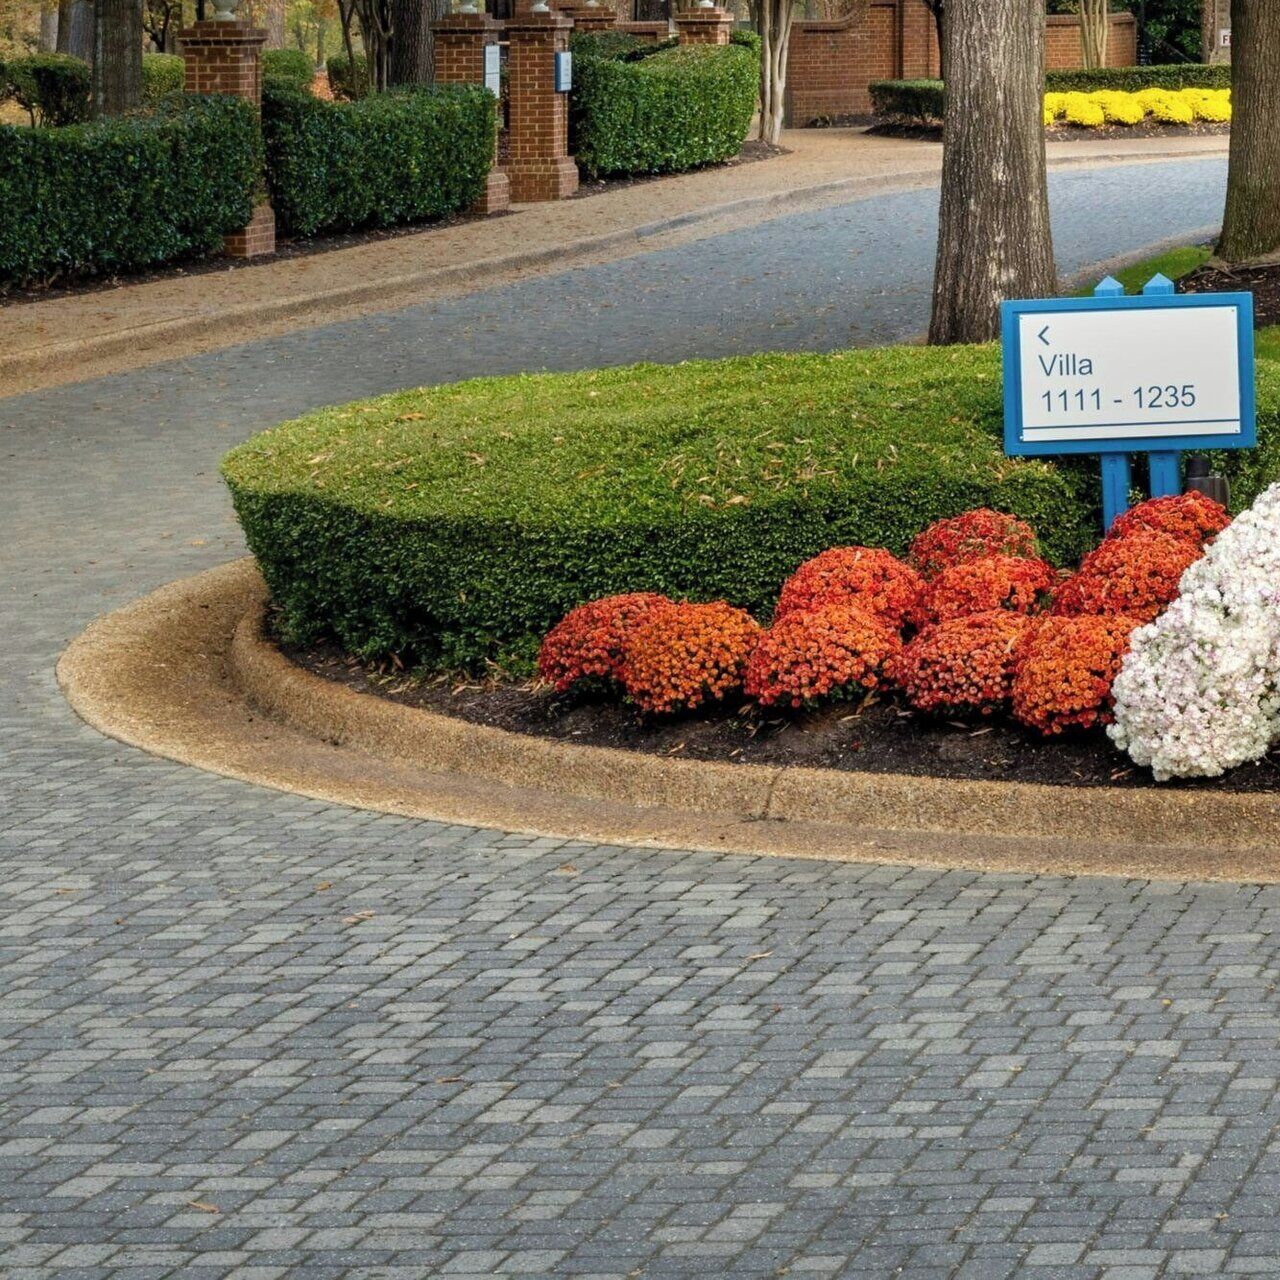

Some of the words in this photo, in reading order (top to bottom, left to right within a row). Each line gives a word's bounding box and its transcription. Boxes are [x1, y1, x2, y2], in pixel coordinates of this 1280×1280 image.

[1038, 353, 1094, 377] Villa
[1041, 388, 1101, 413] 1111
[1133, 384, 1196, 409] 1235
